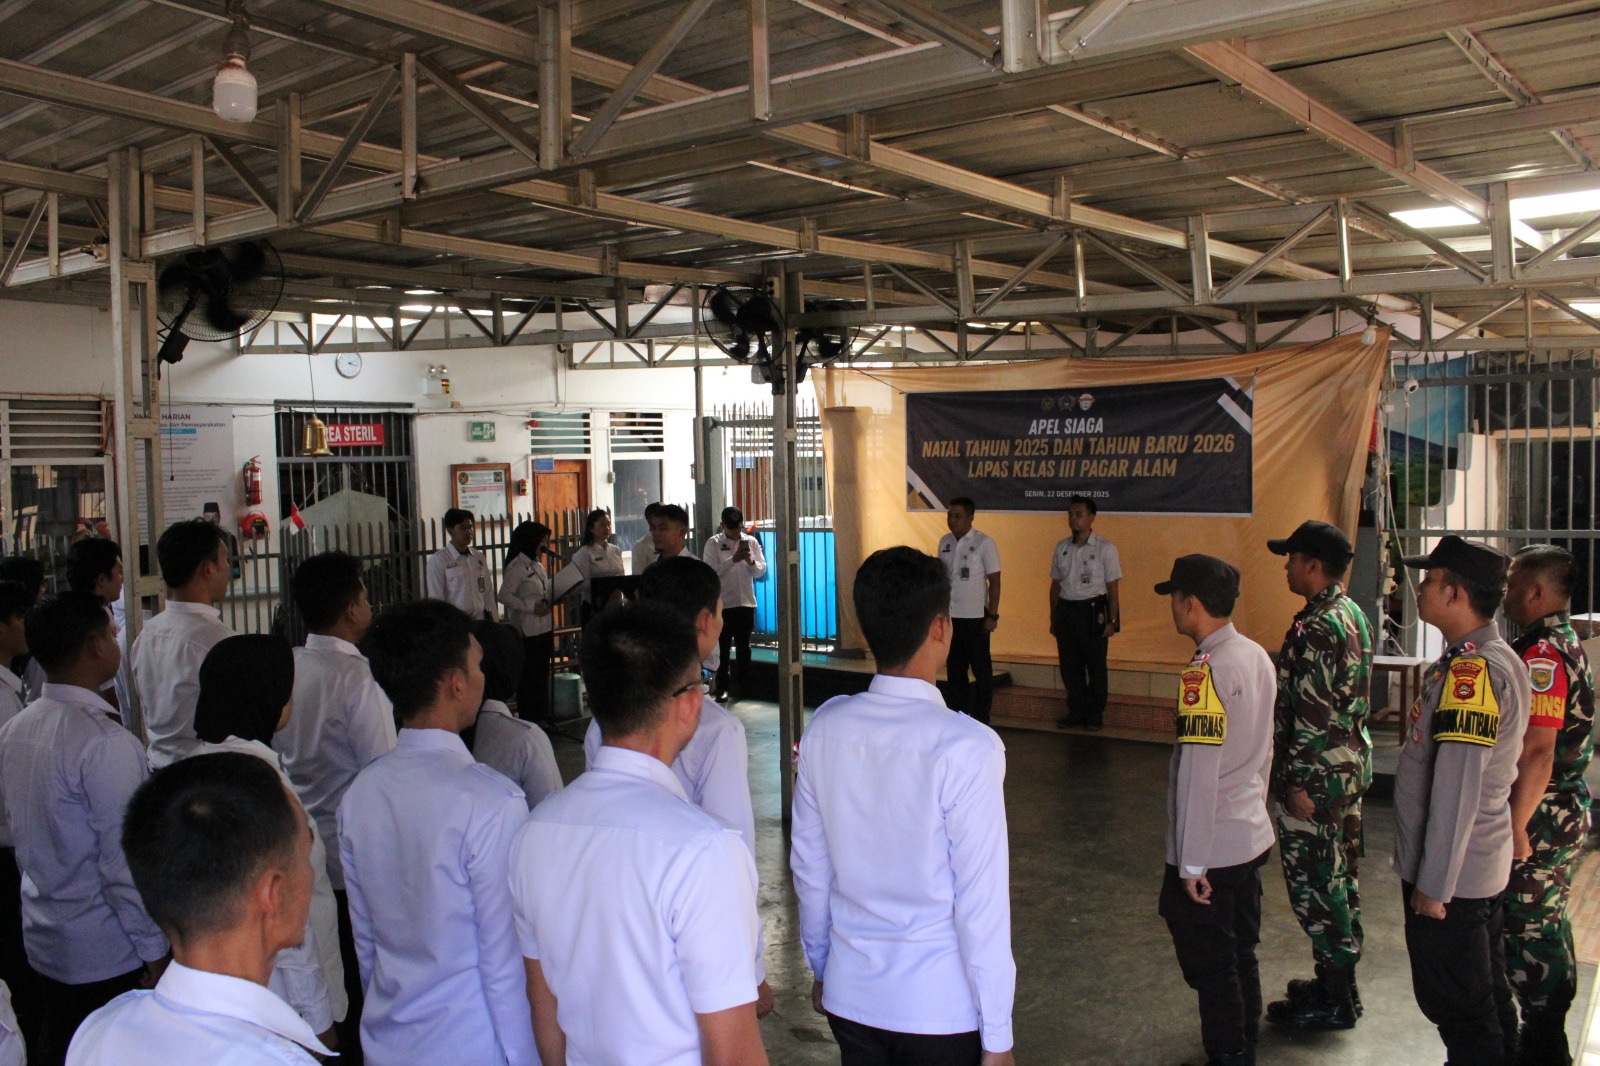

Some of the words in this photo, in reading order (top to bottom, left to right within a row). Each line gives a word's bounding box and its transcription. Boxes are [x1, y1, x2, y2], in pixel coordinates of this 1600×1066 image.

[325, 426, 342, 442] REA
[344, 425, 377, 442] STERIL
[1028, 418, 1060, 435] APEL
[1063, 416, 1104, 434] SIAGA
[922, 440, 961, 458] NATAL
[965, 439, 1011, 457] TAHUN
[1013, 438, 1049, 456] 2025
[1052, 436, 1084, 455] DAN
[1089, 435, 1142, 455] TAHUN
[1144, 434, 1190, 454] BARU
[1192, 432, 1235, 453] 2026
[968, 460, 1009, 478] LAPAS
[1012, 459, 1056, 478] KELAS
[1059, 459, 1077, 477] III
[1080, 458, 1130, 478] PAGAR
[1131, 457, 1179, 478] ALAM
[1024, 490, 1046, 498] SENIN,
[1047, 490, 1055, 498] 22
[1056, 490, 1092, 498] DESEMBER
[1092, 490, 1110, 498] 2025
[1178, 714, 1223, 739] KAMTIBMAS
